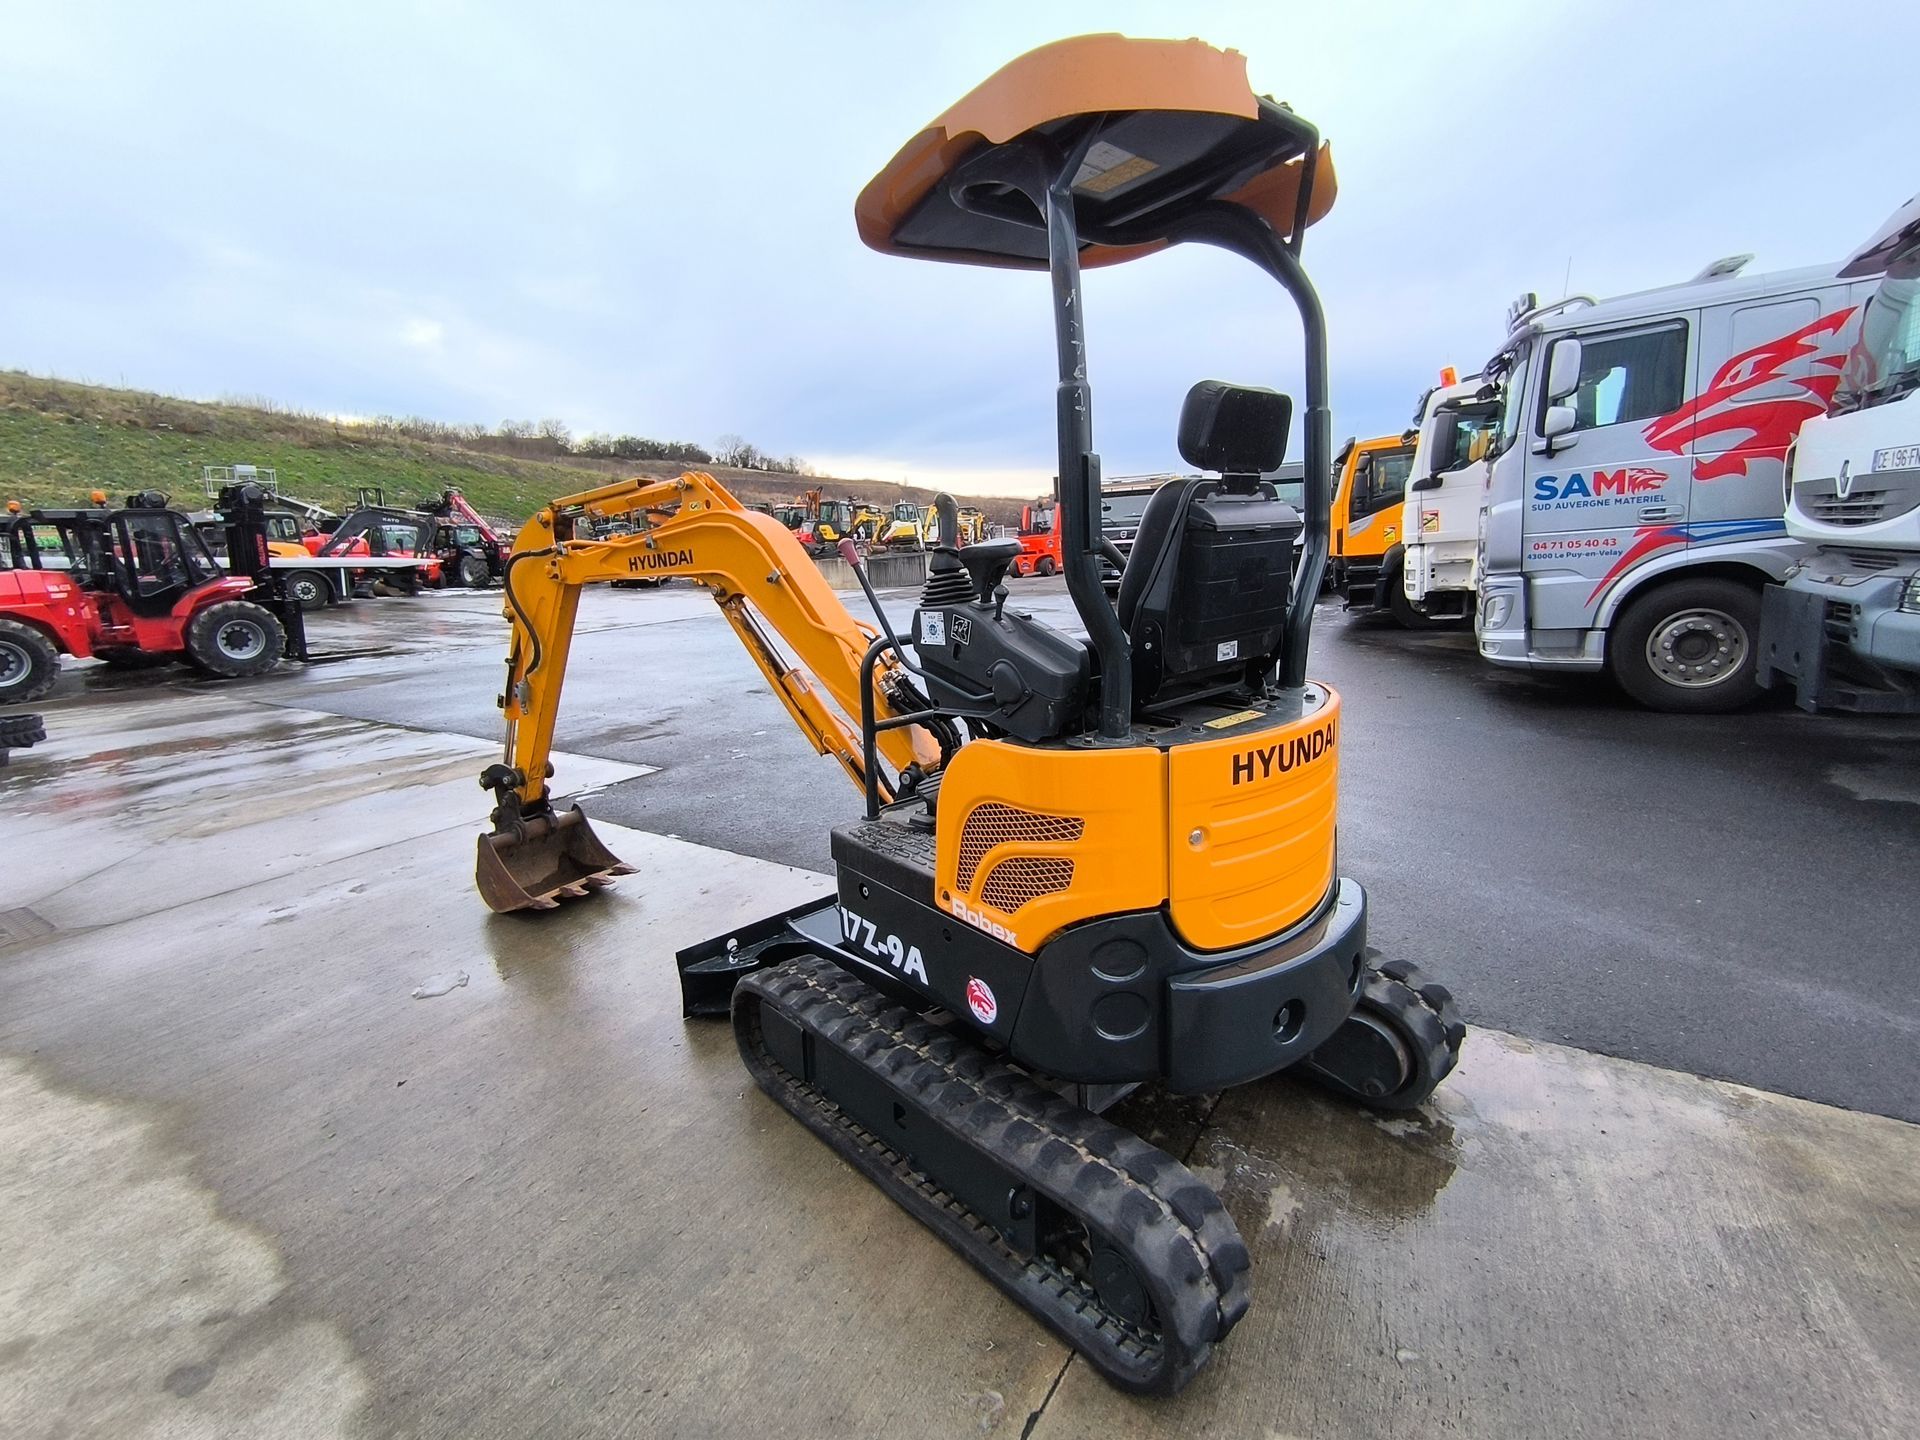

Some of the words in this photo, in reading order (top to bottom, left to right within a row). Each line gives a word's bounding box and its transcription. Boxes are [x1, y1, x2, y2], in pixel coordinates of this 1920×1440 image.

[1533, 469, 1627, 501] SAM
[1531, 503, 1551, 512] SUD
[1555, 498, 1610, 510] AUVERGNE
[1614, 494, 1666, 505] MATERIEL
[1533, 542, 1547, 551] 04
[1550, 541, 1563, 550] 71
[1567, 540, 1581, 549] 05
[1584, 539, 1599, 548] 40
[1602, 538, 1617, 547] 43
[1566, 549, 1623, 559] Puy-en-Velay
[628, 549, 694, 572] HYUNDAI
[1232, 719, 1336, 786] HYUNDAI
